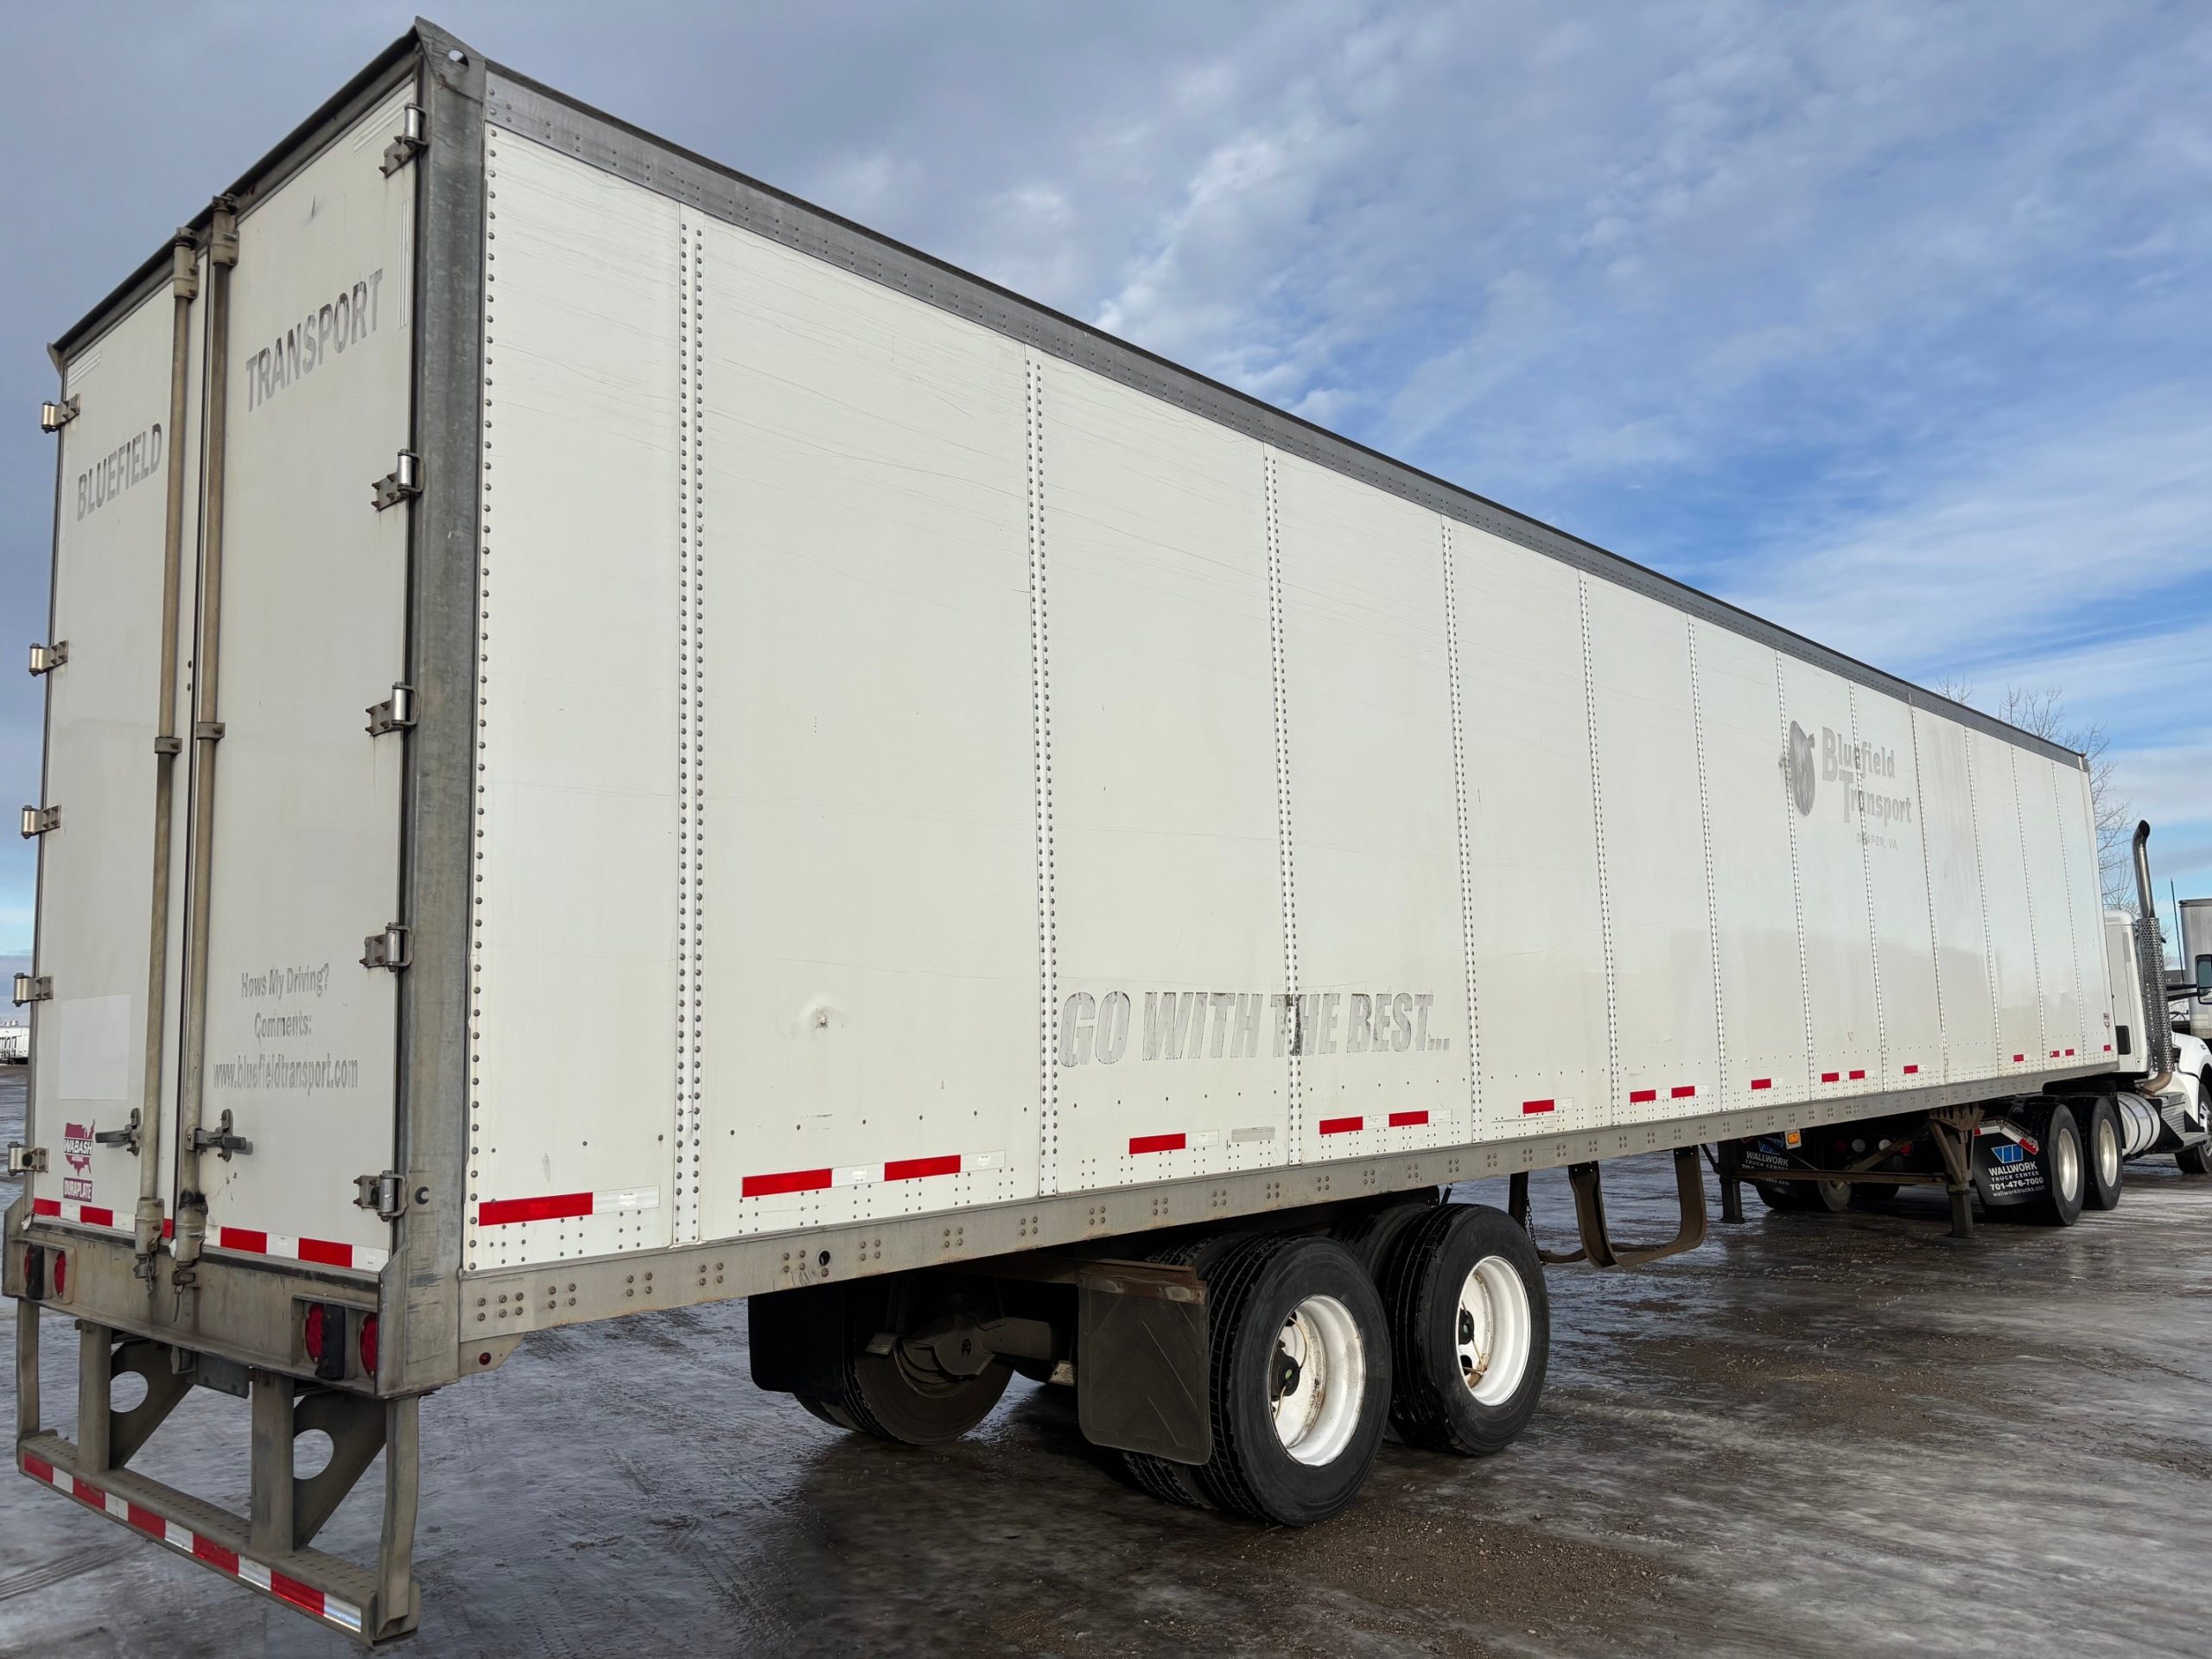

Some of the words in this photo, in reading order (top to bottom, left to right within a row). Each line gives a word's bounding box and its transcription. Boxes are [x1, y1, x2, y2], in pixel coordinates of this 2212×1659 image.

[245, 268, 383, 412] TRANSPORT
[76, 423, 162, 522] BLUEFIELD
[1821, 726, 1896, 782] Bluefield
[1839, 768, 1911, 827] Transport
[269, 969, 284, 1001] My
[287, 963, 329, 997] Driving?
[254, 1010, 312, 1039] Comments:
[1057, 990, 1130, 1068] GO
[1141, 991, 1263, 1061] WITH
[1270, 992, 1341, 1058] THE
[213, 1052, 359, 1096] www.bluefieldtransport.com
[64, 1139, 92, 1155] WABASH
[1745, 1150, 1789, 1167] WALLWORK
[1745, 1159, 1764, 1167] TRUCK
[1988, 1160, 2038, 1177] WALLWORK
[2015, 1170, 2039, 1179] CENTER
[64, 1179, 92, 1199] DURAPLATE
[1989, 1176, 2044, 1192] 701-476-7000
[1993, 1185, 2045, 1197] wallworktrucks.com
